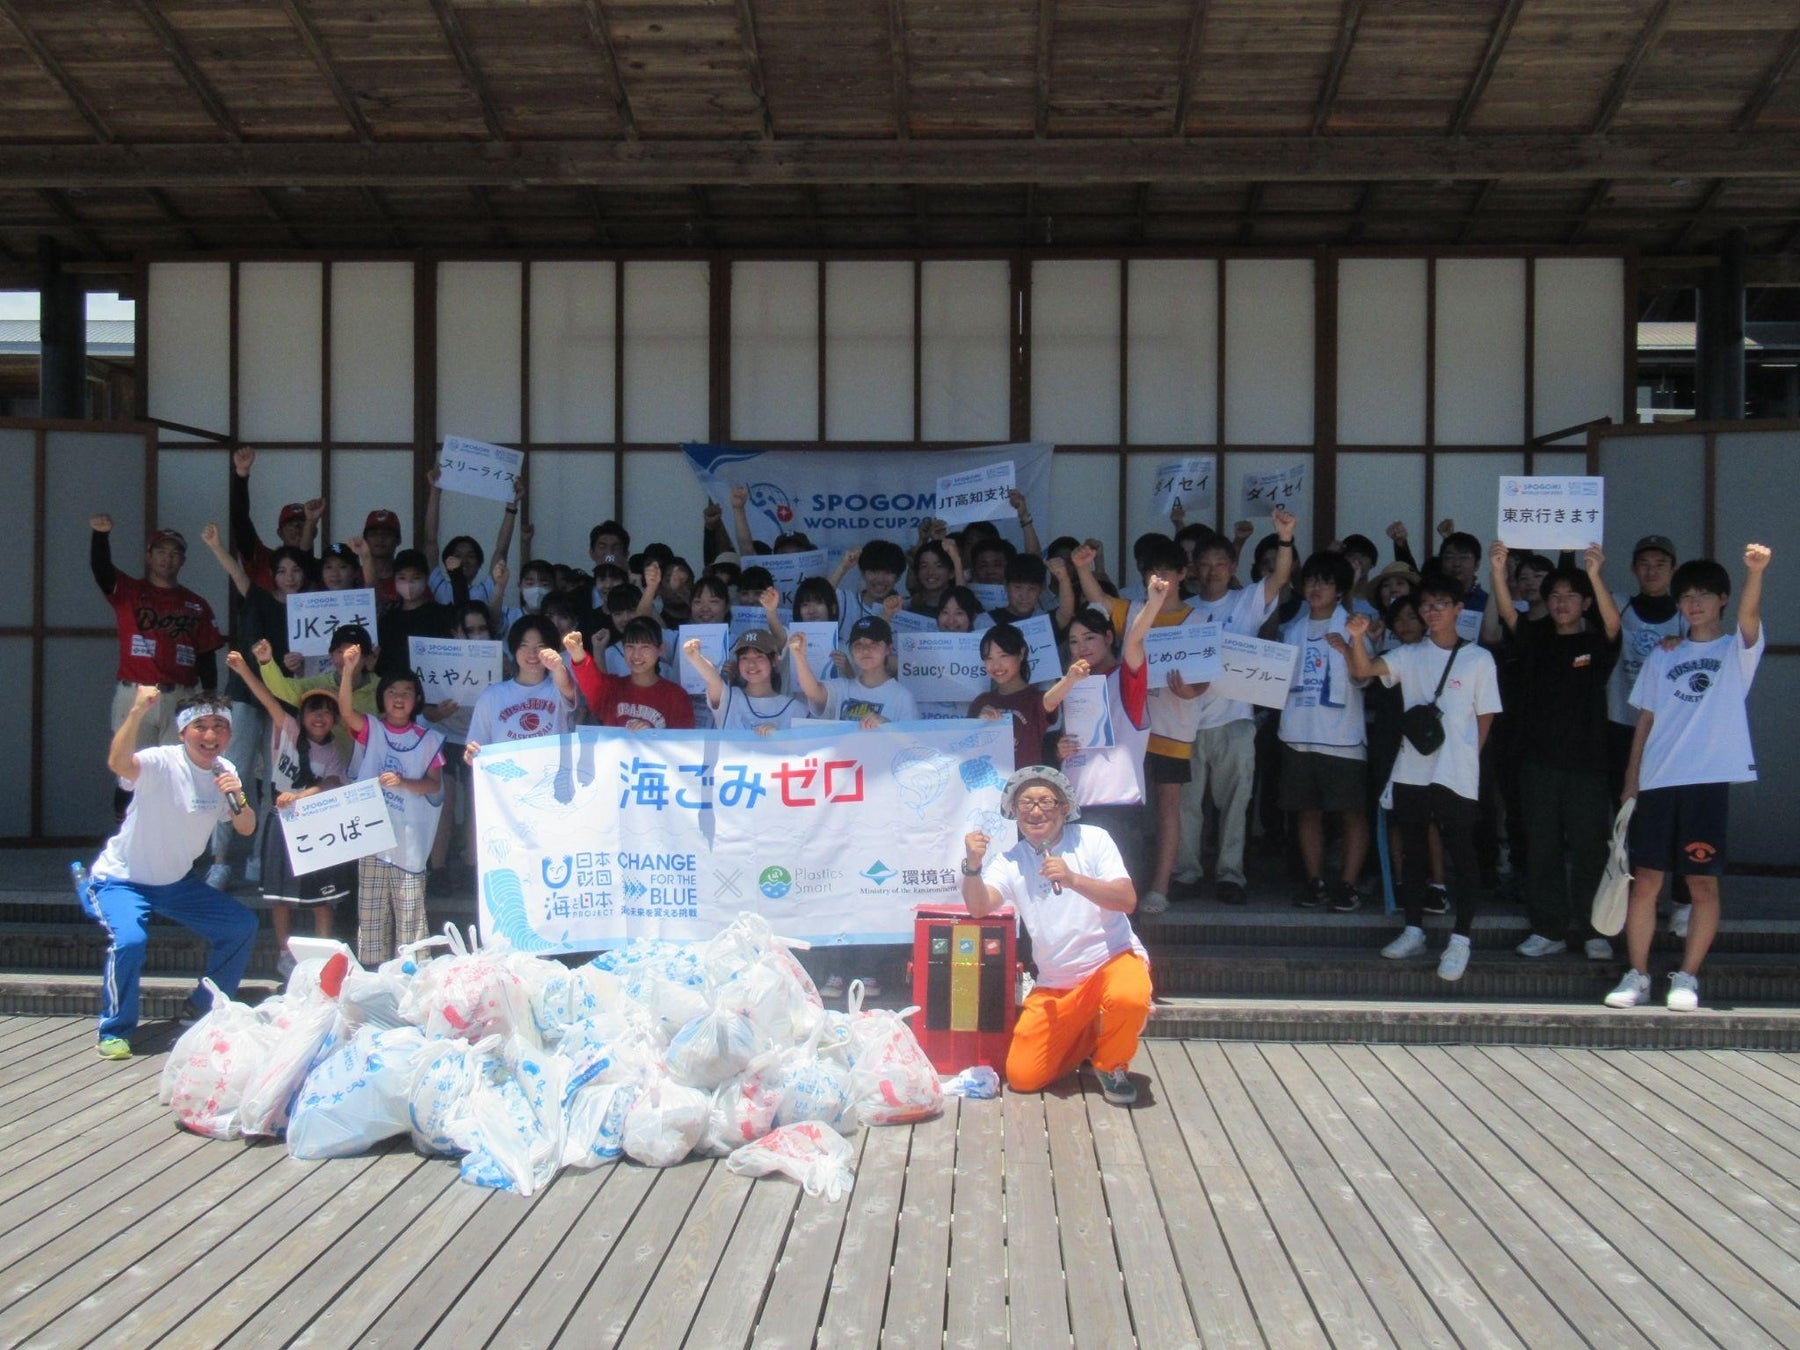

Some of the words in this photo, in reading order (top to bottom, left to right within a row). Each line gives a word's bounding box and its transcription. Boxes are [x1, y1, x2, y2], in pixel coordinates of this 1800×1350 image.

[441, 459, 514, 482] スリーライス
[939, 484, 1010, 510] JT高知支社
[803, 517, 869, 529] WORLD
[873, 517, 907, 529] CUP
[1503, 507, 1599, 523] 東京行きます
[902, 662, 944, 679] Saucy
[950, 662, 987, 678] Dogs
[620, 756, 864, 811] 海ごみゼロ
[296, 816, 384, 853] こっぱー
[576, 852, 611, 868] 日本
[617, 852, 697, 871] CHANGE
[577, 869, 612, 887] 財団
[650, 873, 675, 885] FOR
[677, 874, 697, 885] THE
[794, 867, 844, 881] Plastics
[902, 868, 956, 885] 環境省
[650, 887, 698, 906] BLUE
[795, 882, 832, 894] Smart
[860, 887, 890, 895] Ministry
[913, 885, 958, 894] Environment
[572, 910, 614, 918] PROJECT
